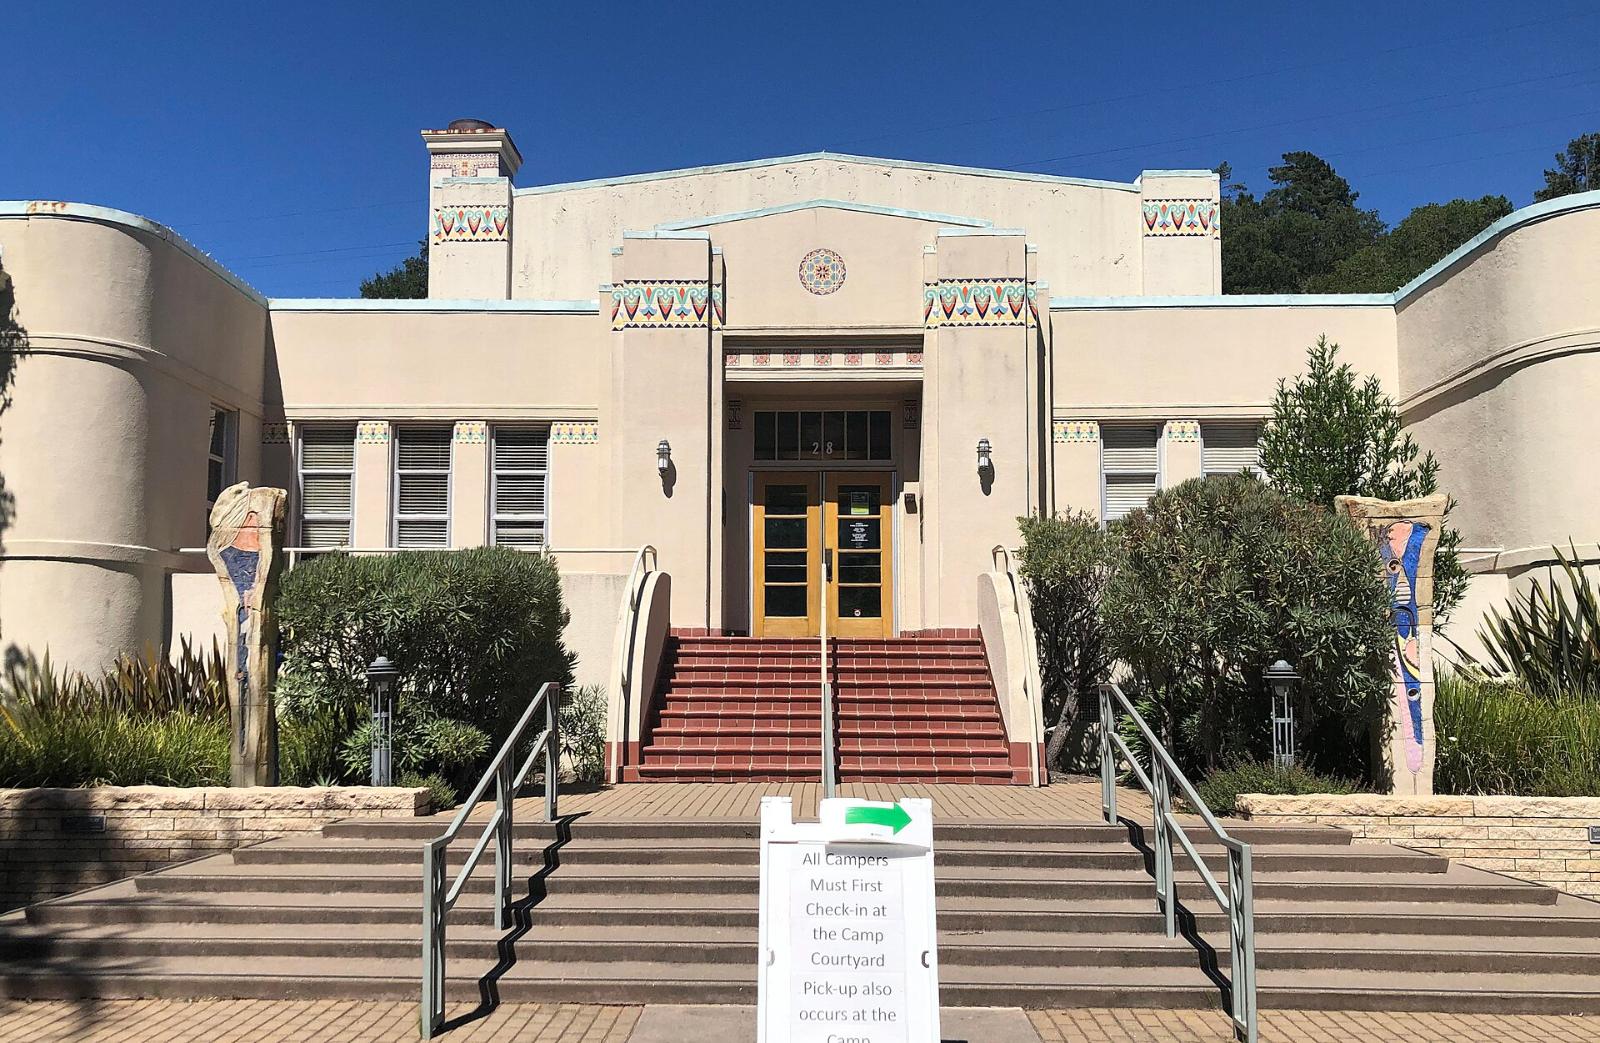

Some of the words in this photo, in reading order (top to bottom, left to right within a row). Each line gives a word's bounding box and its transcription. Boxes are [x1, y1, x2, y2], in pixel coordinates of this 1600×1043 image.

[812, 441, 833, 455] 28
[802, 853, 821, 866] All
[825, 853, 889, 868] Campers
[810, 878, 847, 892] Must
[852, 878, 883, 893] First
[805, 902, 868, 917] Check-in
[872, 904, 887, 917] at
[813, 926, 837, 941] the
[841, 927, 884, 944] Camp
[810, 951, 886, 969] Courtyard
[803, 980, 858, 998] Pick-up
[862, 981, 893, 996] also
[799, 1009, 848, 1021] occurs
[852, 1008, 867, 1021] at
[871, 1006, 897, 1022] the
